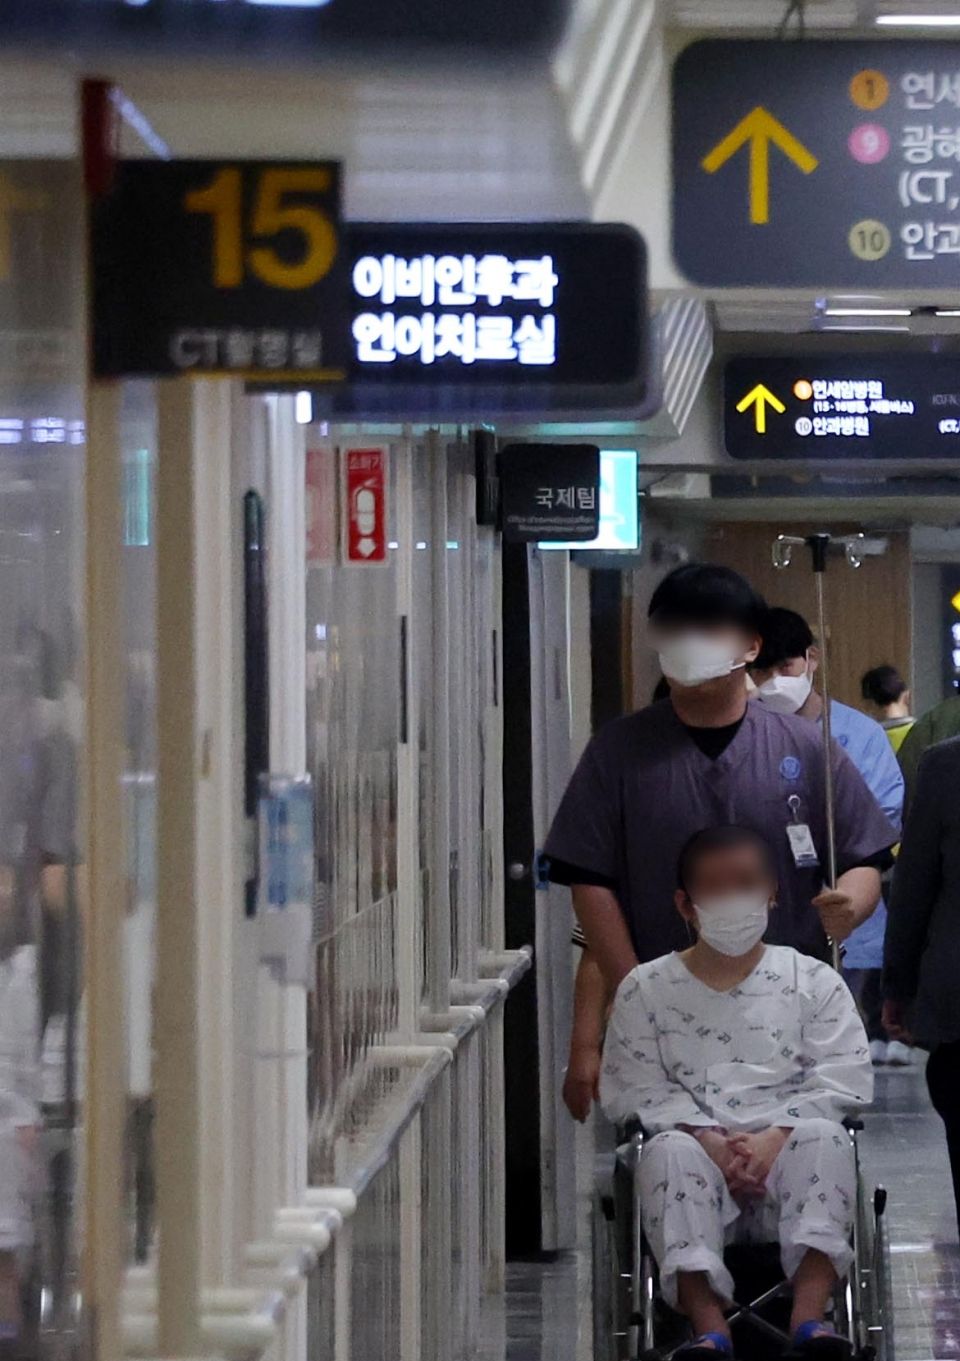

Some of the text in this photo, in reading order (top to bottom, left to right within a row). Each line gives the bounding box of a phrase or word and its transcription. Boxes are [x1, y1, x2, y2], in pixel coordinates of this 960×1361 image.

[184, 167, 337, 290] 15
[857, 229, 886, 252] 10
[353, 254, 559, 307] 이비인후과
[352, 312, 557, 364] 언어치료실
[535, 486, 595, 509] 국제팀
